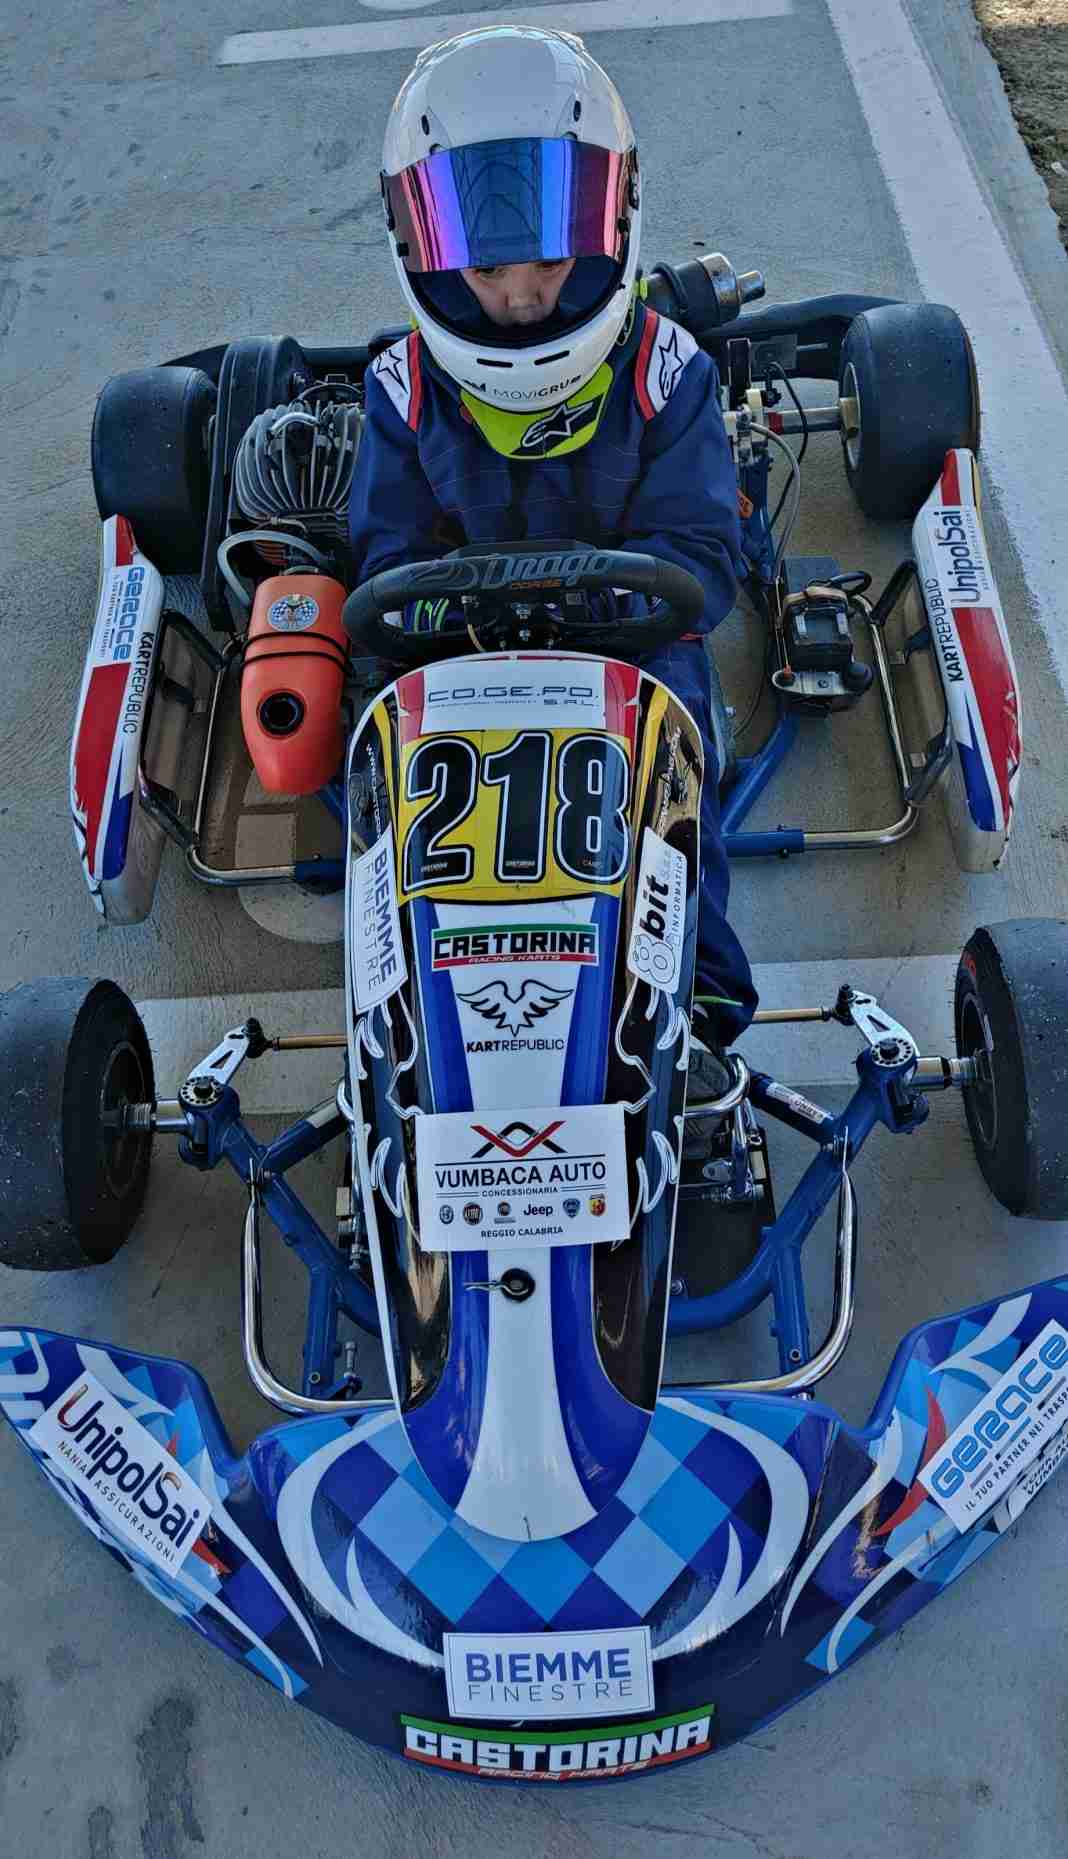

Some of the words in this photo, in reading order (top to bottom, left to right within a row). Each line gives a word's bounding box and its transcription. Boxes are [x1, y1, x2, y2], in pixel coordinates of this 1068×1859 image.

[934, 509, 980, 603] UnipolSai
[925, 578, 964, 683] KARTREPUBLIC
[122, 631, 155, 734] KARTREPUBLIC
[403, 731, 630, 893] 218
[361, 863, 382, 991] FINESTRE
[374, 849, 397, 983] BIEMME
[671, 855, 684, 933] INFORMATICA
[433, 931, 596, 959] CASTORINA
[468, 955, 515, 964] RACING
[518, 954, 561, 962] KARTS
[466, 1039, 565, 1053] KARTREPUBLIC
[435, 1166, 543, 1189] VUMBACA
[549, 1161, 606, 1182] AUTO
[481, 1186, 559, 1198] CONCESSIONARIA
[480, 1229, 516, 1239] REGGIO
[518, 1225, 564, 1236] CALABRIA
[523, 1203, 554, 1217] Jeep
[57, 1383, 201, 1549] UnipolSai
[965, 1499, 978, 1511] IL
[975, 1480, 994, 1500] TUO
[993, 1438, 1031, 1480] PARTNER
[1028, 1419, 1045, 1438] NEI
[1043, 1387, 1068, 1420] TRASP
[93, 1479, 176, 1562] ASSICURAZIONI
[465, 1647, 632, 1683] BIEMME
[467, 1679, 633, 1702] FINESTRE
[405, 1715, 711, 1772] CASTORINA
